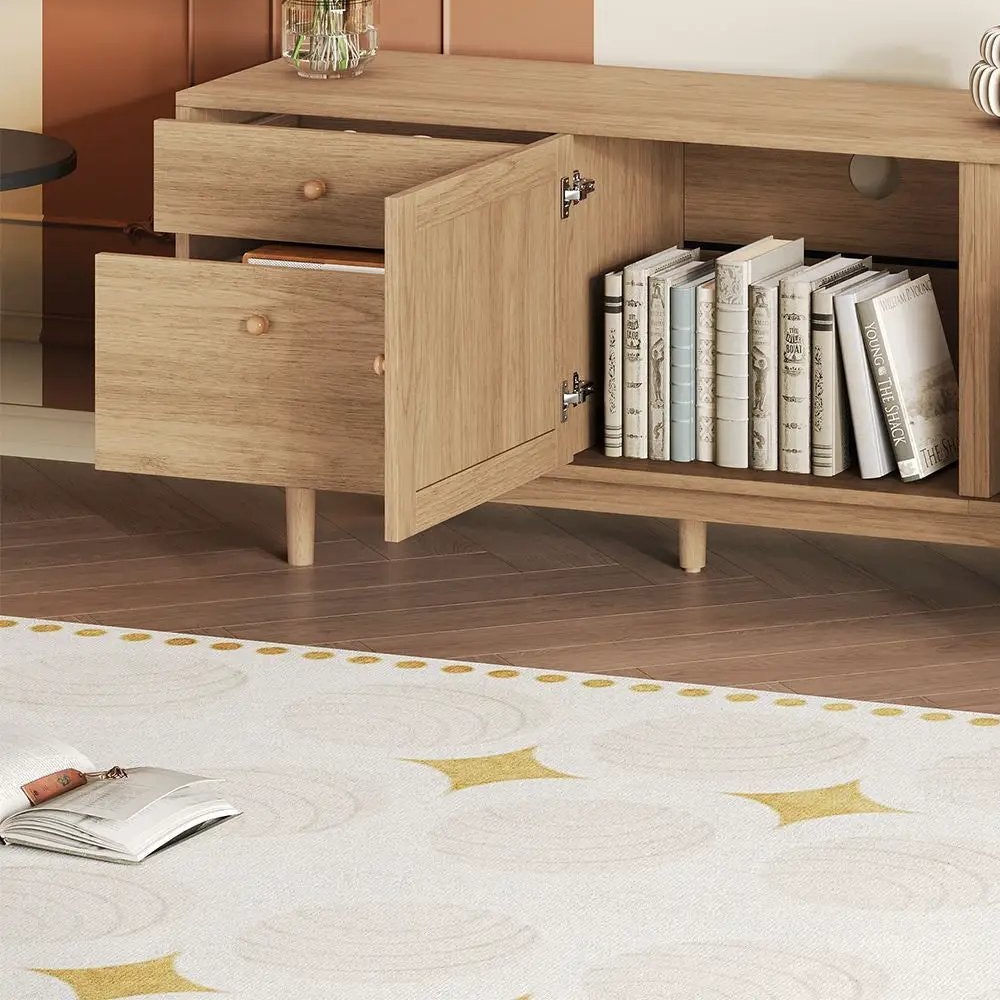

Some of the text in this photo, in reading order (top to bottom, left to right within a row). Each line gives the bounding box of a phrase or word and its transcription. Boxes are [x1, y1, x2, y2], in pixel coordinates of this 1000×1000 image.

[864, 321, 907, 447] YOUNG THE SHACK
